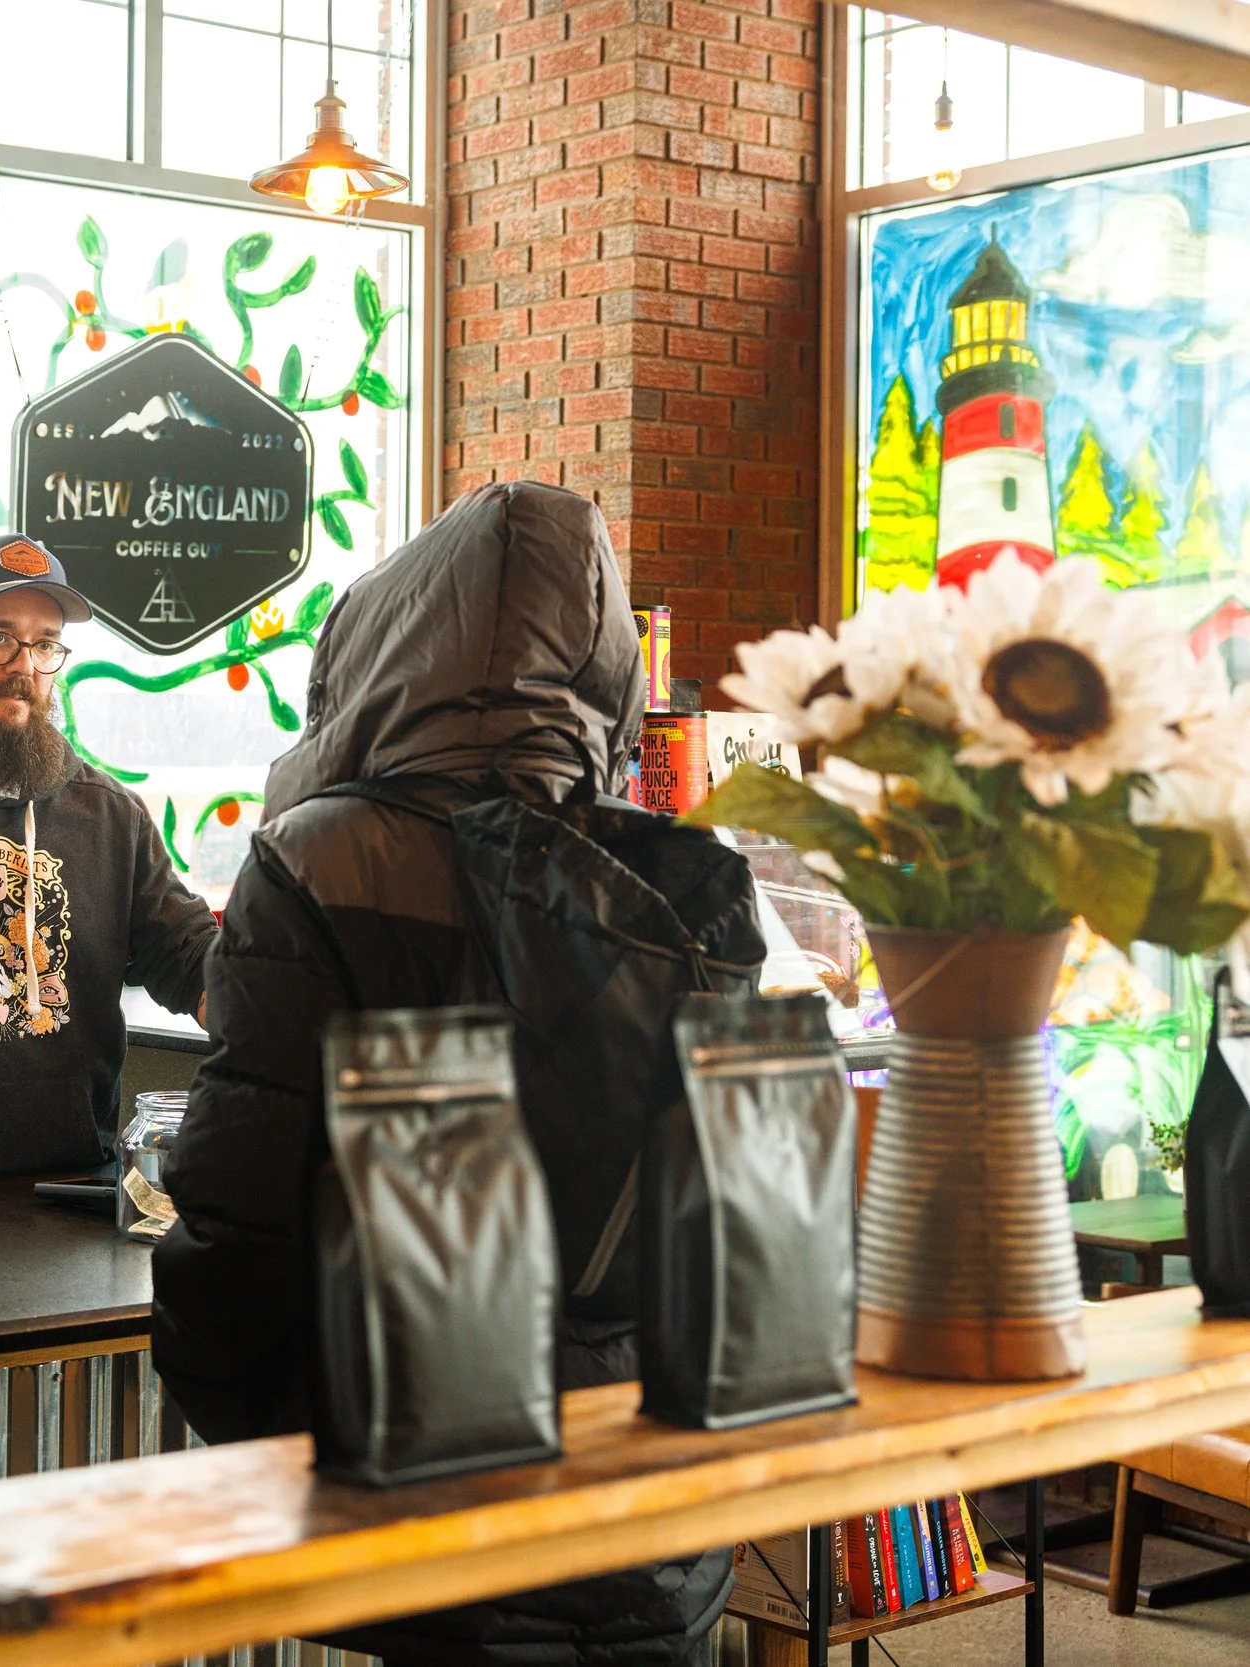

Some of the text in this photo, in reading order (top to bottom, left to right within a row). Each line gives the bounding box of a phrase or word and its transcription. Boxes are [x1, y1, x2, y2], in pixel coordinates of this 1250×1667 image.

[242, 432, 284, 450] 2022
[44, 471, 290, 529] NEW ENGLAND
[116, 540, 182, 558] COFFEE
[660, 733, 668, 750] A
[641, 770, 678, 788] PUNCH
[645, 789, 677, 808] FACE.
[952, 1529, 962, 1567] HANNAH
[955, 1527, 965, 1563] KRISTIN
[872, 1569, 881, 1587] LOVE
